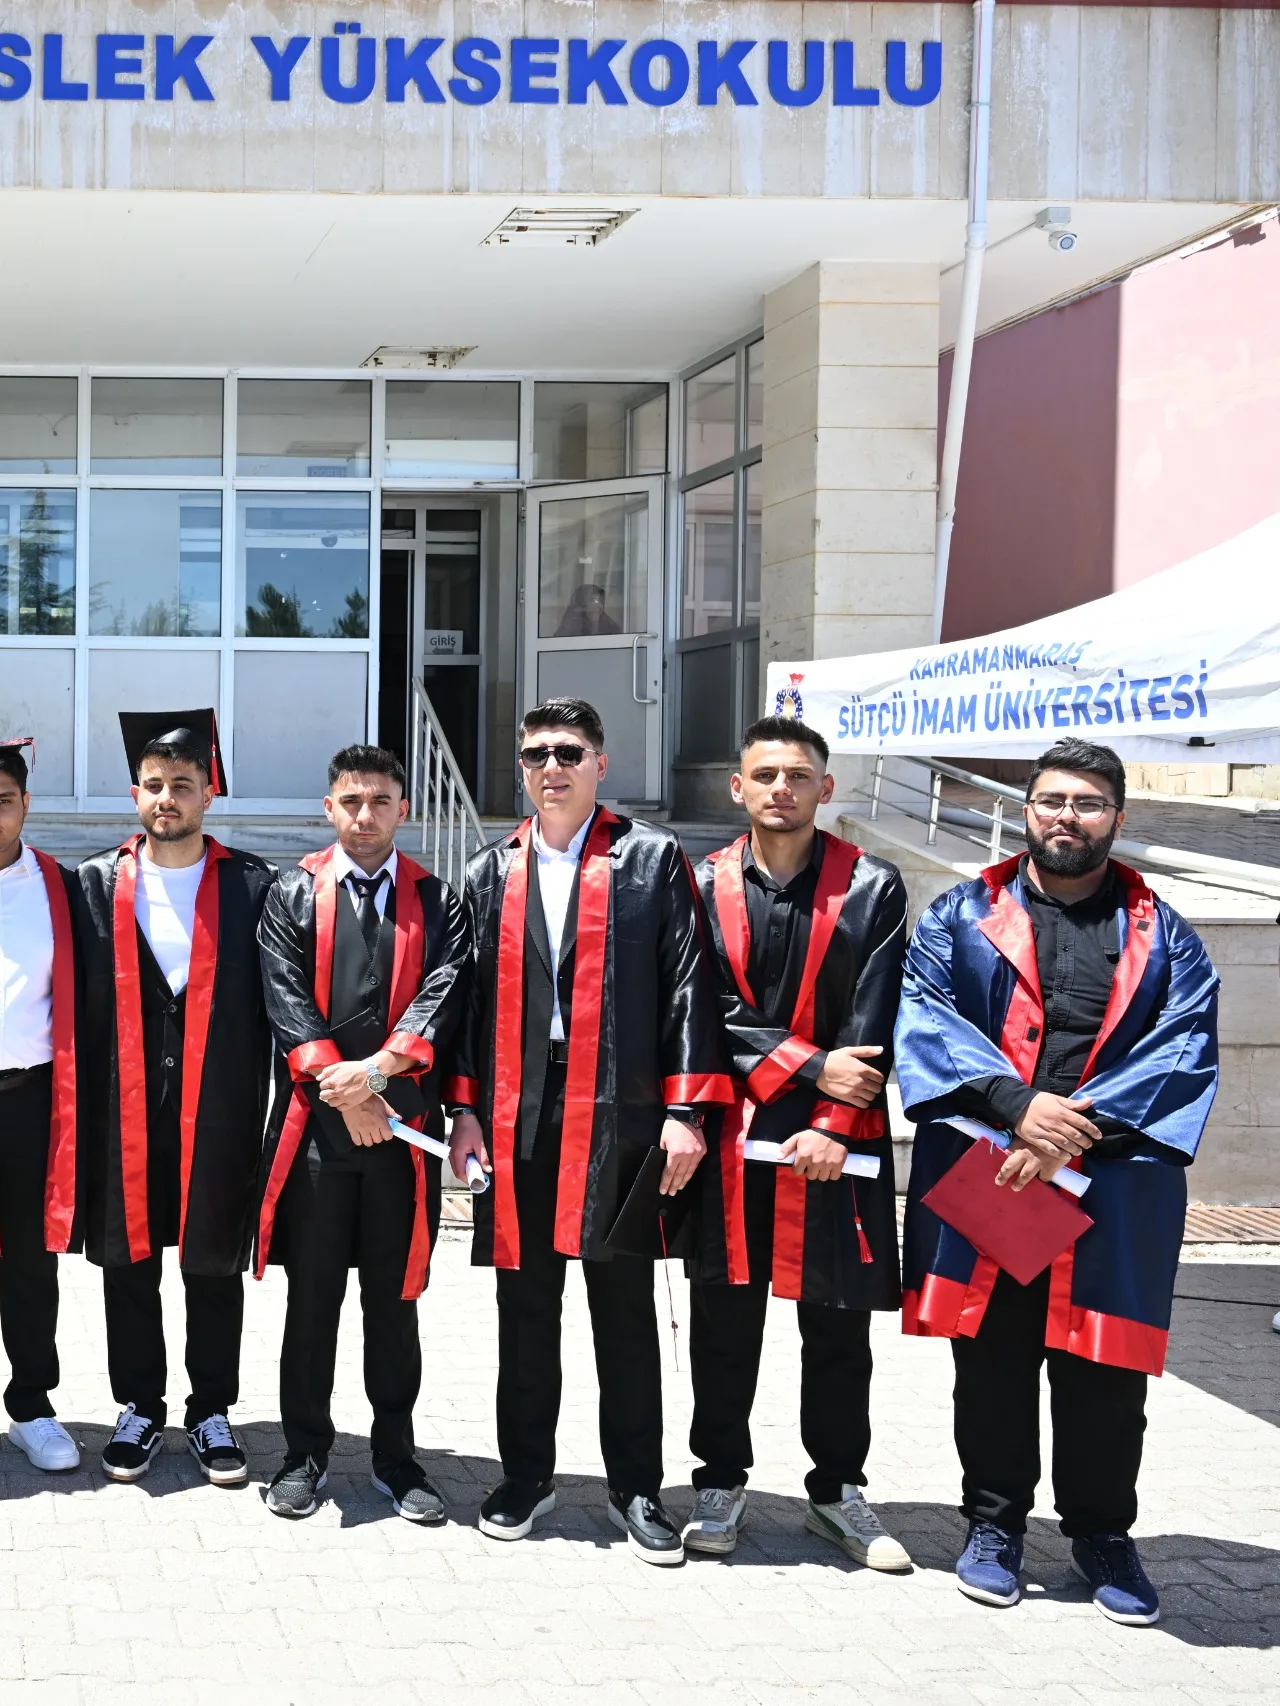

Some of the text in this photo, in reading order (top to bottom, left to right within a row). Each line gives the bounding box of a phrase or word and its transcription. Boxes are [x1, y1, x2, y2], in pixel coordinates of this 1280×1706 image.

[251, 21, 943, 108] YÜKSEKOKULU
[430, 635, 456, 647] GİRİŞ
[909, 640, 1092, 681] KAHRAMANMARAŞ
[837, 658, 1209, 746] SÜTÇÜ İMAM ÜNİVERSİTESİ
